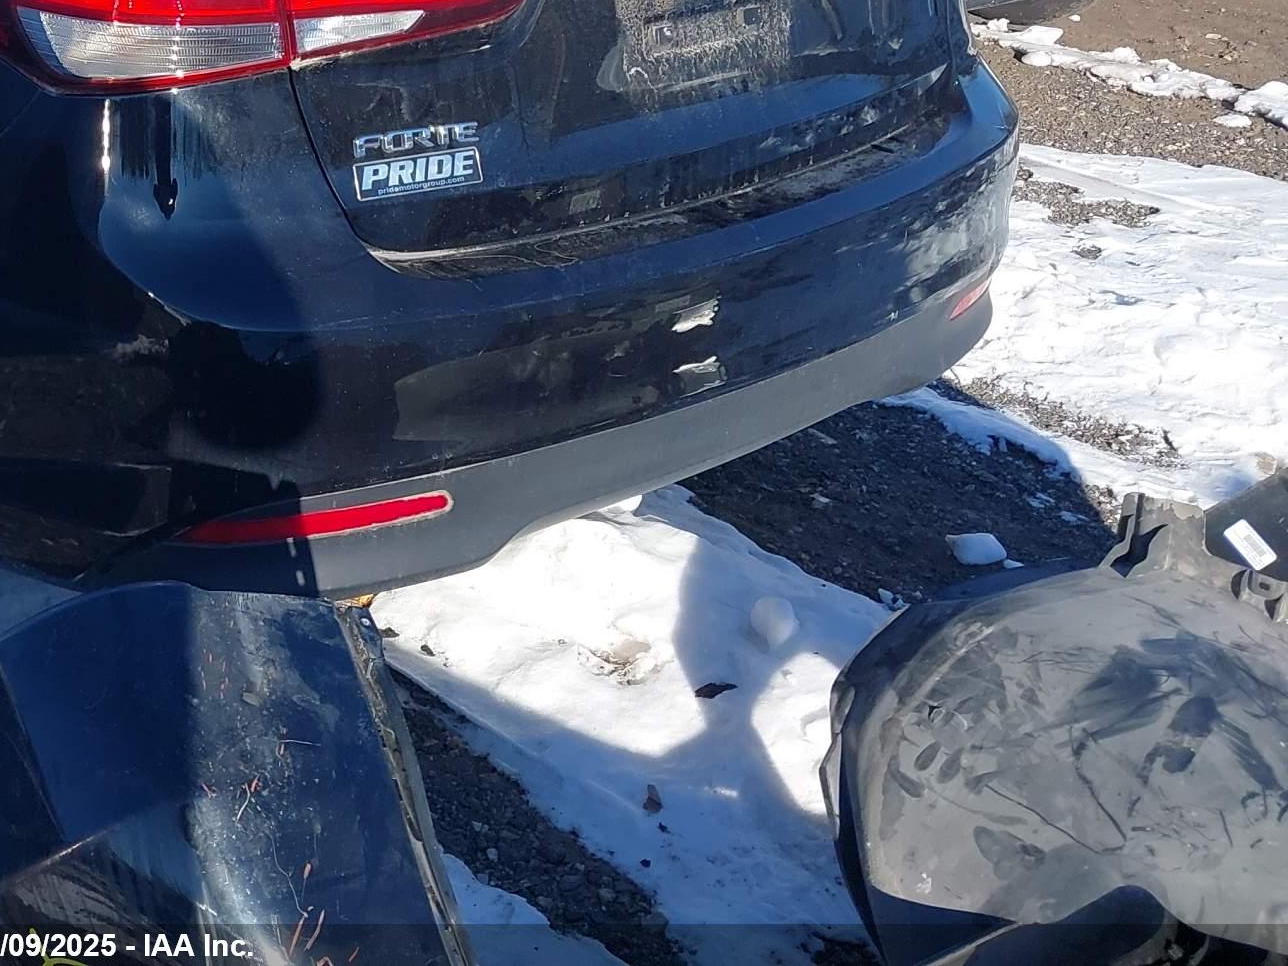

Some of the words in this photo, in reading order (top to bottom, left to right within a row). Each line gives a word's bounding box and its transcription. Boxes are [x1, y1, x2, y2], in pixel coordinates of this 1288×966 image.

[353, 121, 480, 158] FORTE
[361, 150, 475, 191] PRIDE
[377, 176, 465, 195] pridemotorgroup.com
